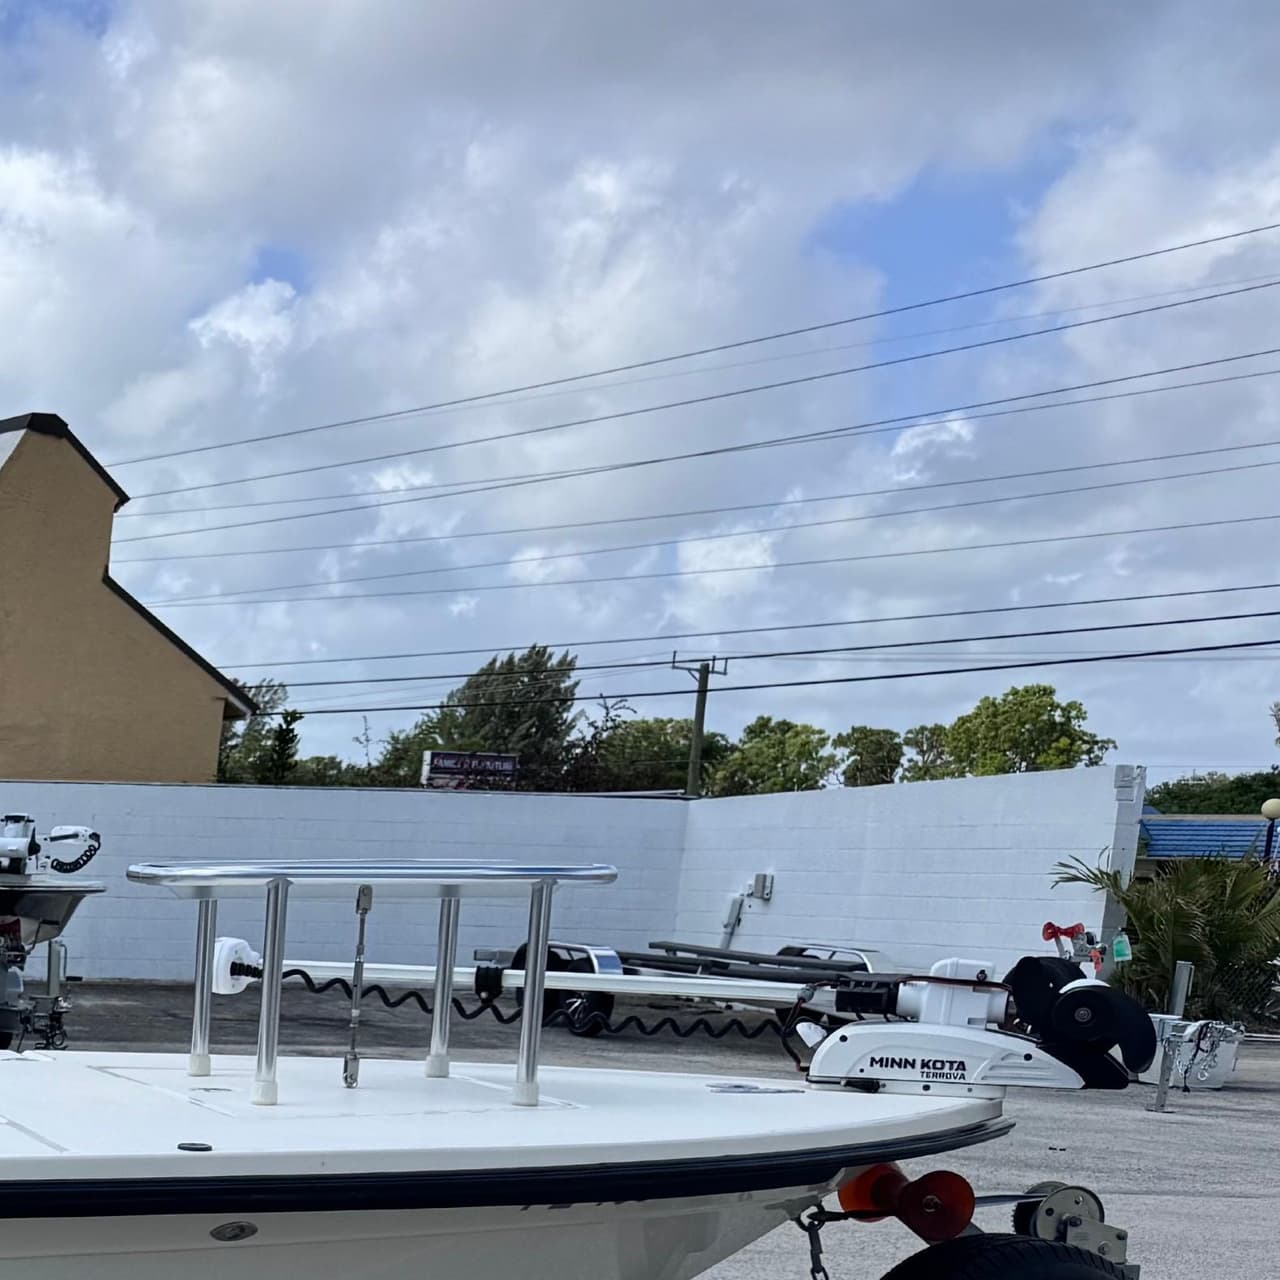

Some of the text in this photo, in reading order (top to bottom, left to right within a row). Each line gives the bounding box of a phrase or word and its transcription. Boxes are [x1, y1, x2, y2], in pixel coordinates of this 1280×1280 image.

[869, 1056, 967, 1072] MINN KOTA
[920, 1071, 967, 1081] TERROVA
